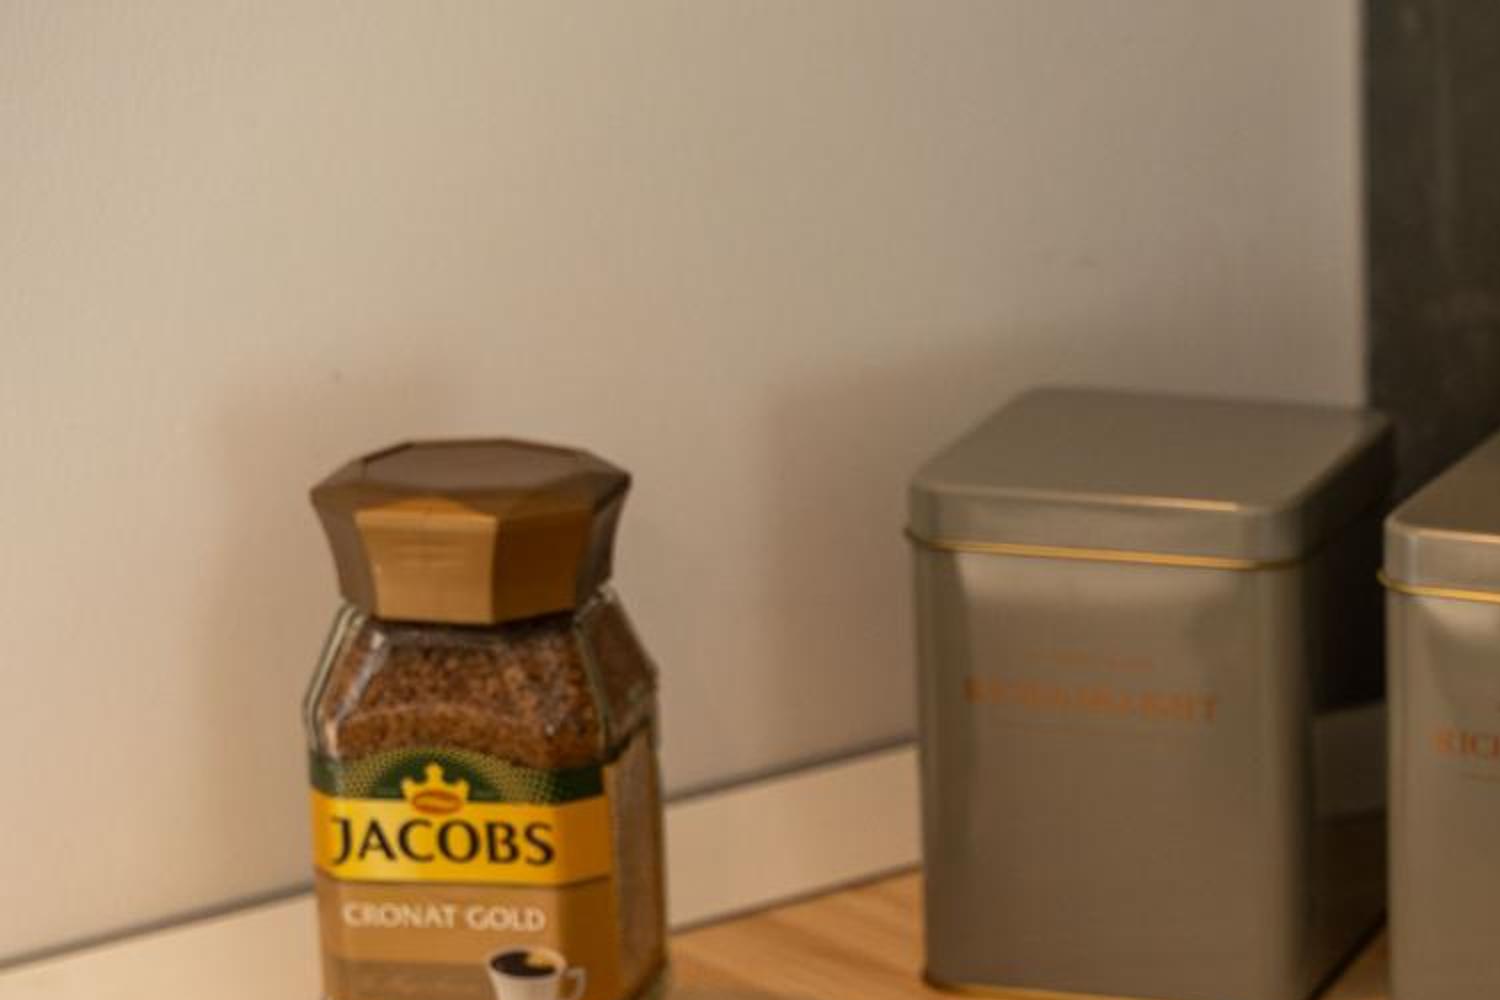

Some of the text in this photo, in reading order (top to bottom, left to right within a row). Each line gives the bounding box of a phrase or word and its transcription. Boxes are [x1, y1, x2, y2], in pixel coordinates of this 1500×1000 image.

[331, 817, 556, 866] JACOBS
[342, 903, 546, 932] CRONAT GOLD
